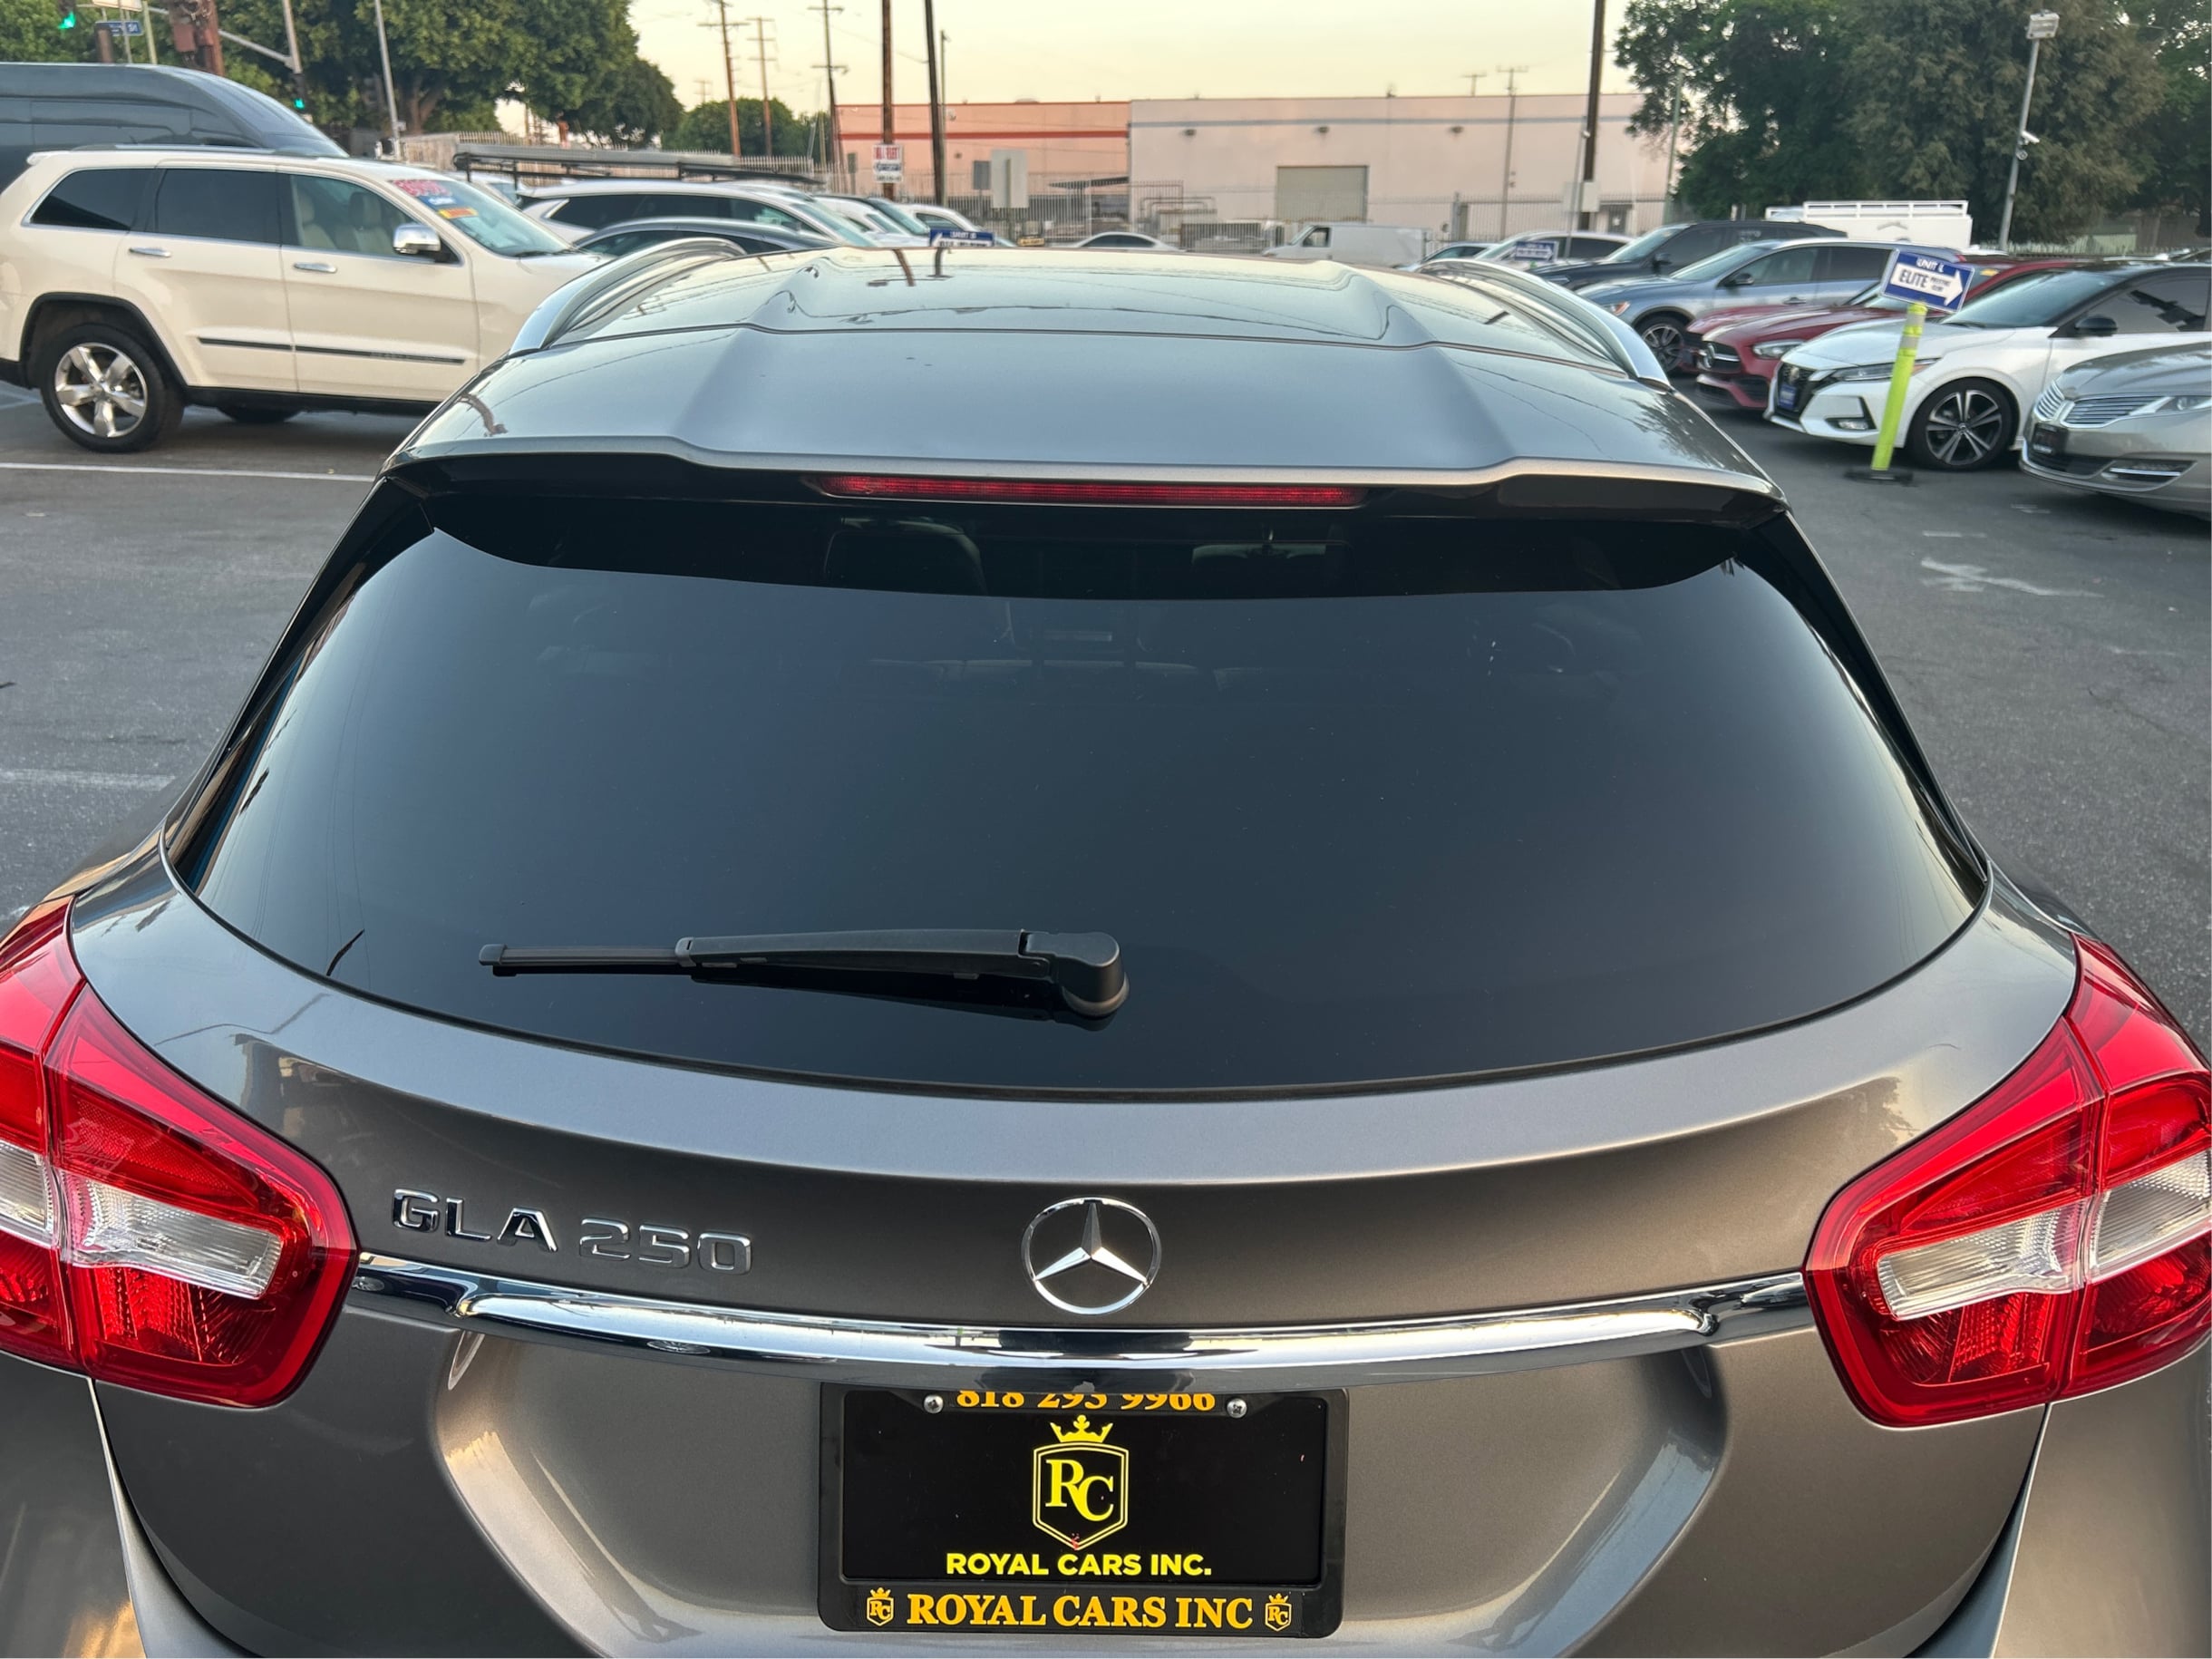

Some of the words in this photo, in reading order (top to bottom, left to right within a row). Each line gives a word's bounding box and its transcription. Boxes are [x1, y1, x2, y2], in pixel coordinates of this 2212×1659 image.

[1899, 268, 1929, 288] ELITE
[1916, 258, 1937, 271] UNIT
[393, 1188, 558, 1253] GLA
[579, 1218, 752, 1276] 250
[1045, 1459, 1114, 1522] RC
[946, 1553, 1049, 1575] ROYAL
[1057, 1554, 1142, 1576] CARS
[1150, 1554, 1212, 1576] INC.
[907, 1594, 1047, 1626] ROYAL
[1053, 1596, 1167, 1628] CARS
[1175, 1597, 1253, 1630] INC
